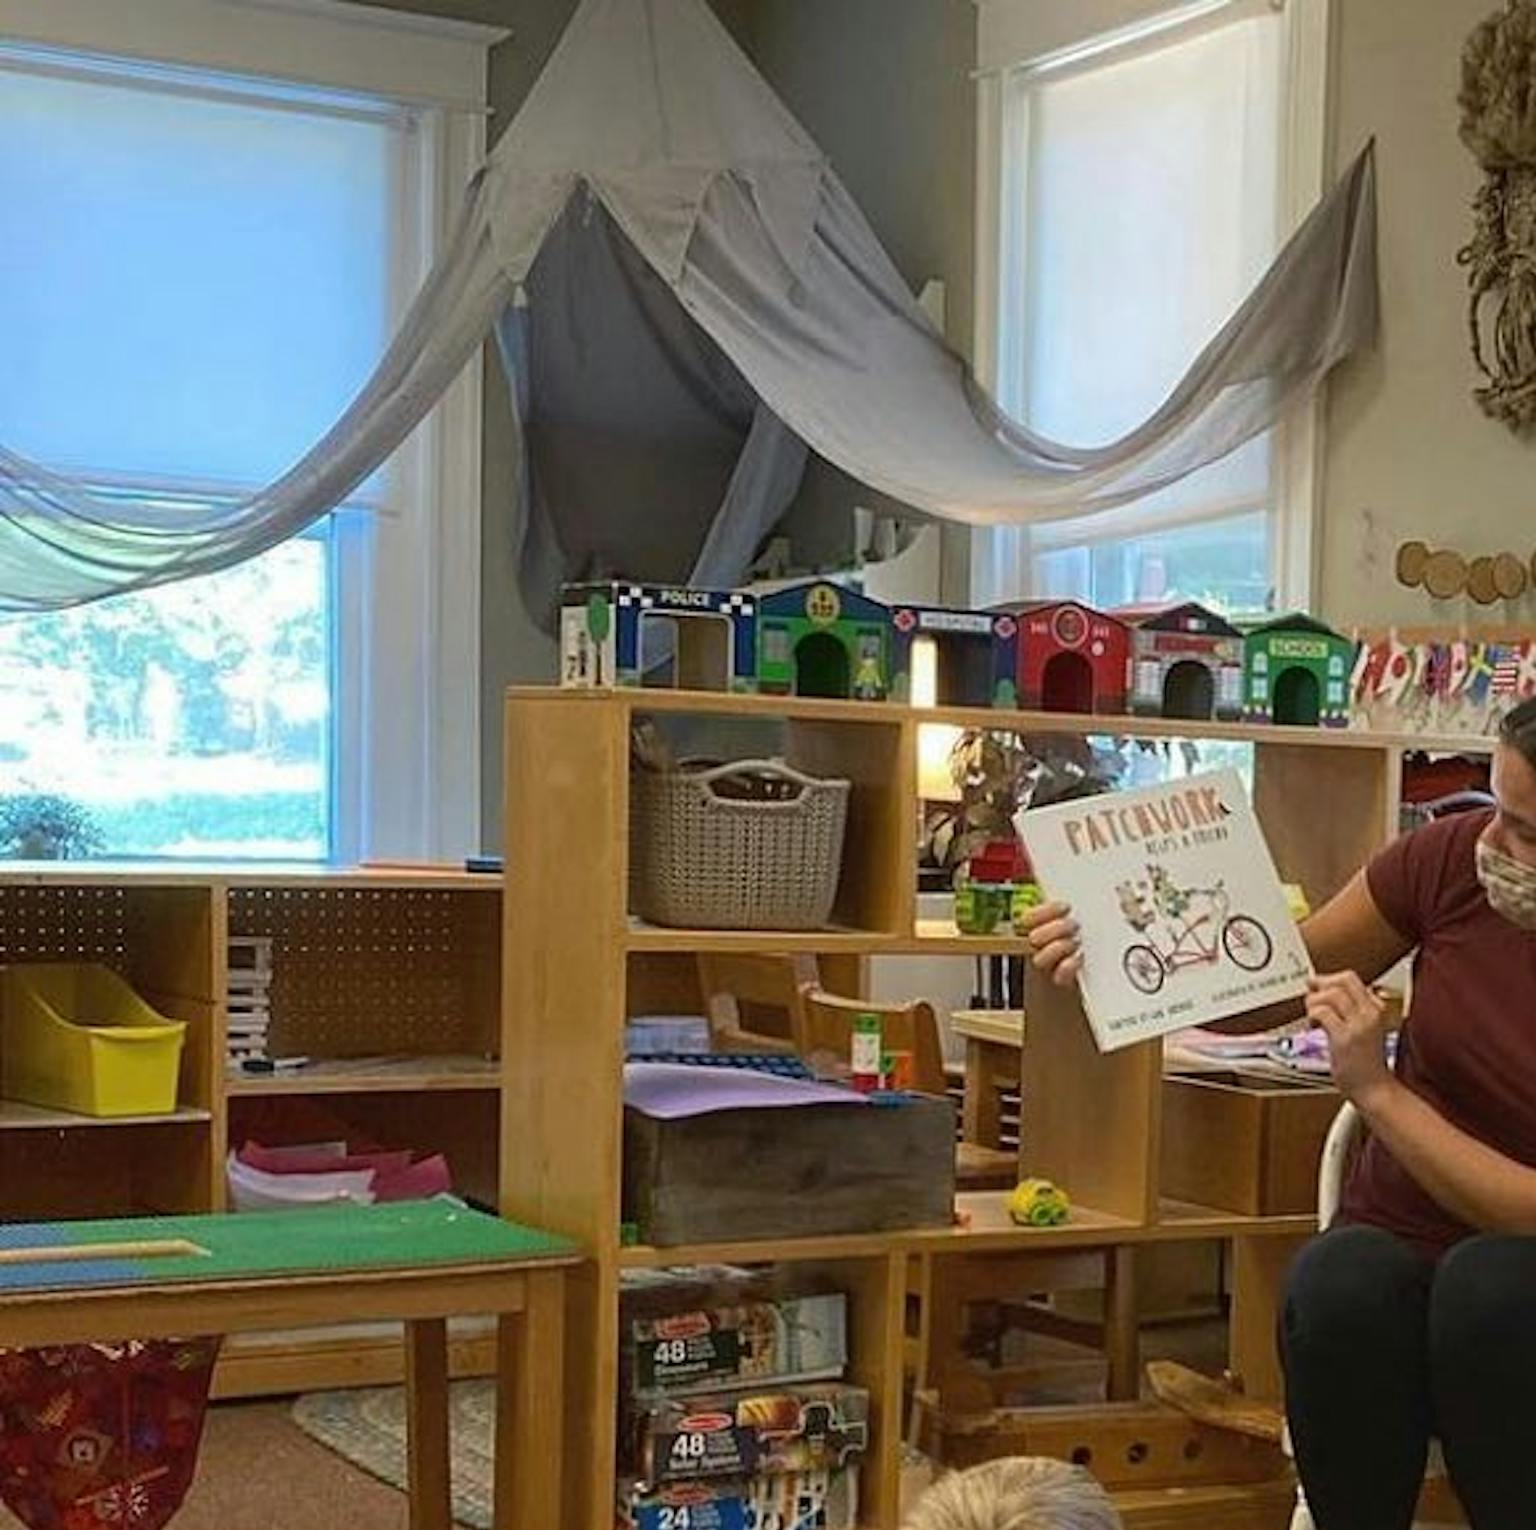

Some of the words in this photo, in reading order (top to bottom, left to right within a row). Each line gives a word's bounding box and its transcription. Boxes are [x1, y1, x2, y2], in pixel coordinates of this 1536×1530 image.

[660, 590, 711, 606] POLICE
[1272, 640, 1324, 655] SCHOOL
[1063, 786, 1227, 855] PATCHWORK
[653, 1339, 687, 1364] 48
[671, 1433, 706, 1458] 48
